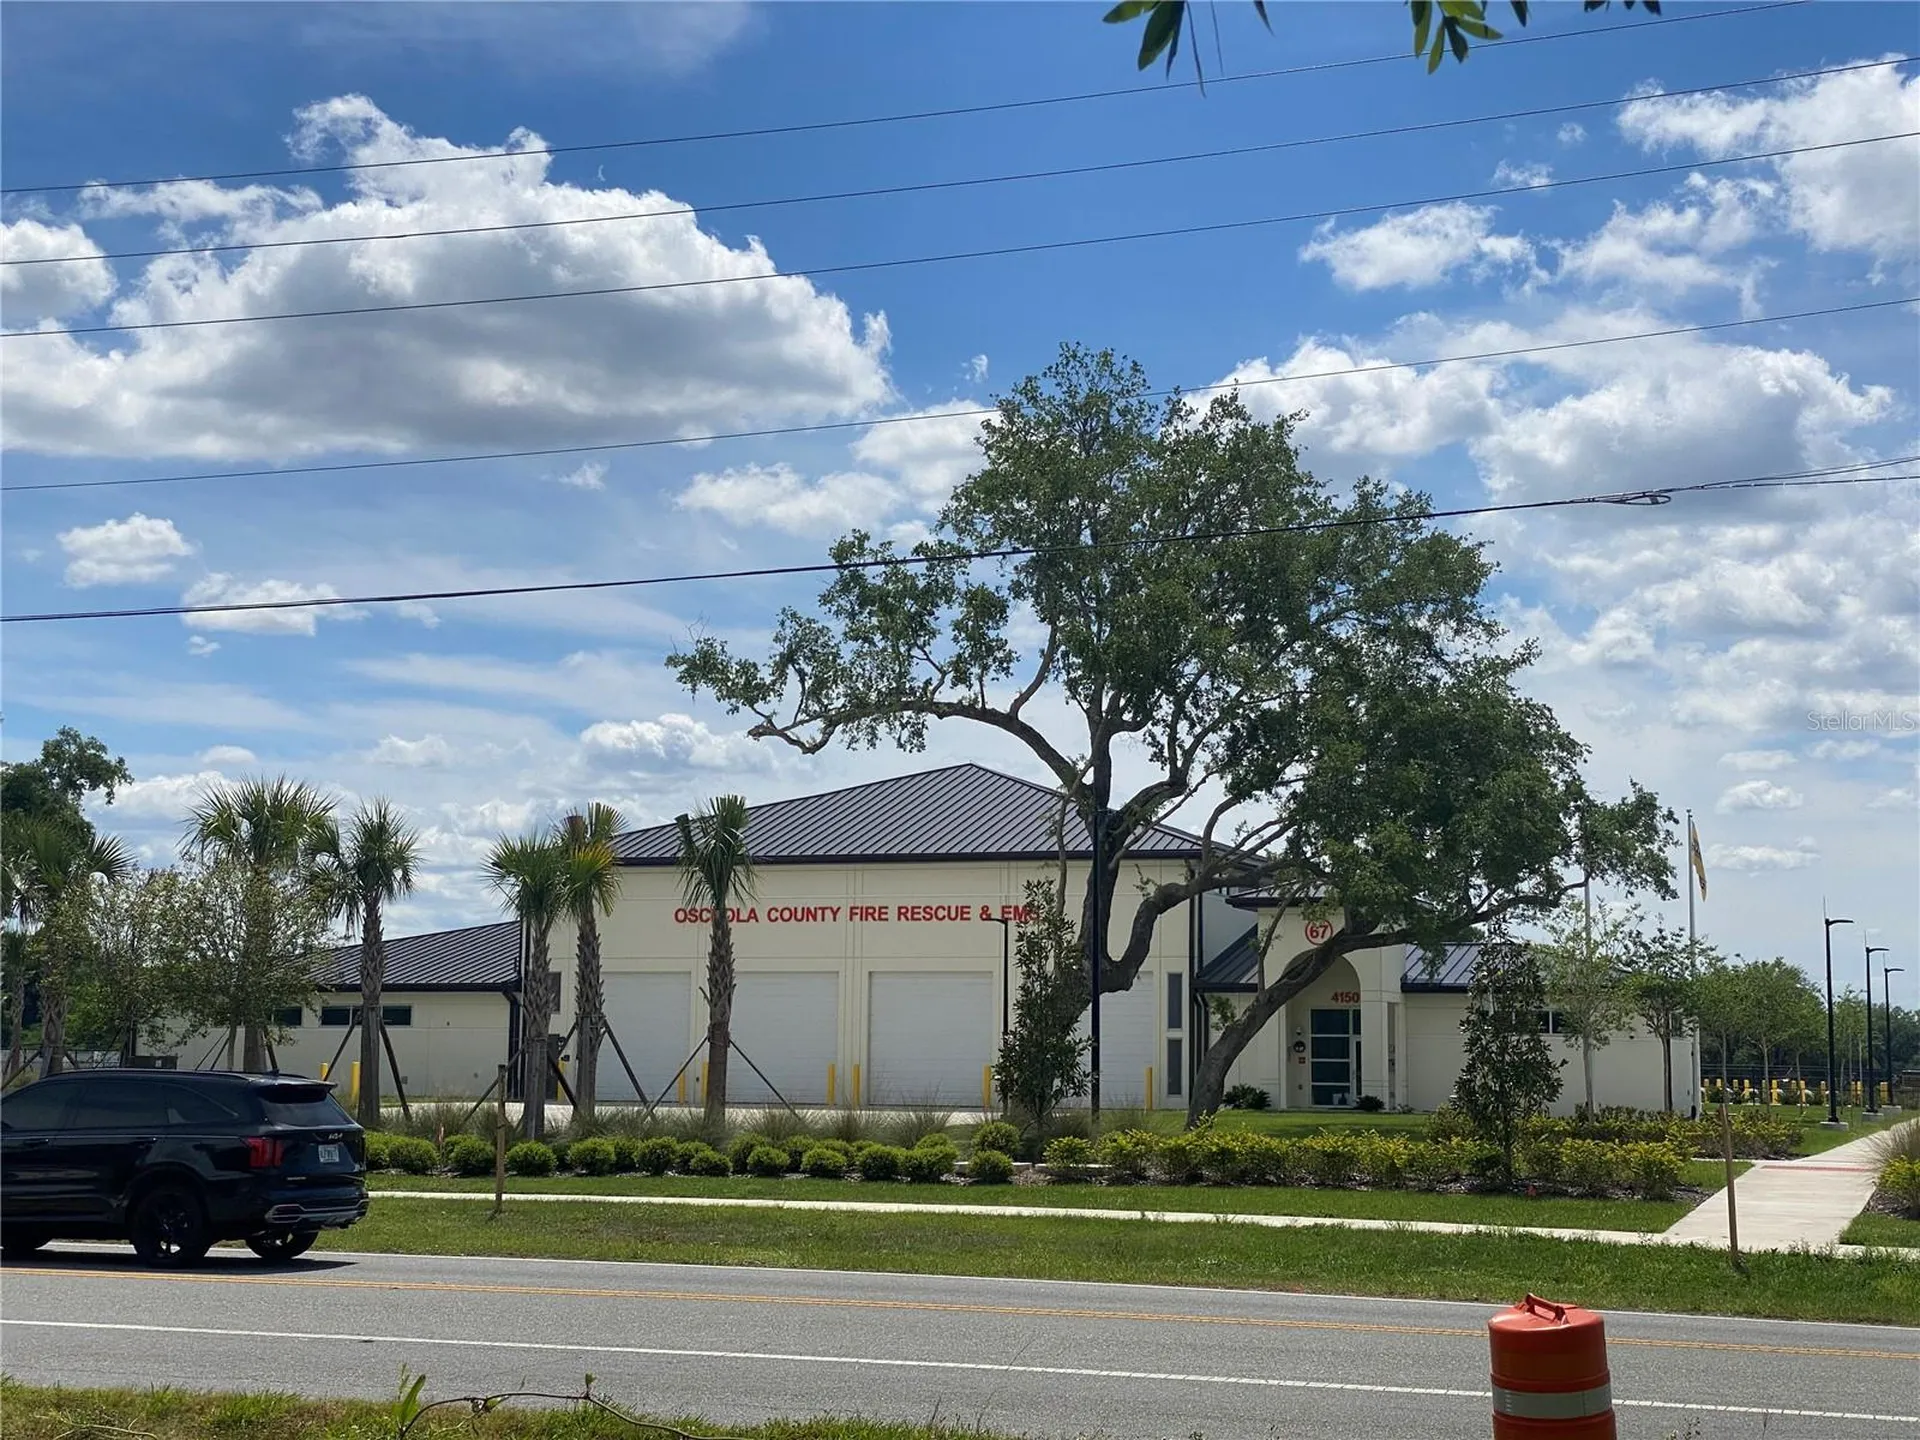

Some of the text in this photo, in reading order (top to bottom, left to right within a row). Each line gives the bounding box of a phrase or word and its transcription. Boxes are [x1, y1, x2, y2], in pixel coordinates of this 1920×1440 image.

[674, 907, 760, 923] OSCOLA
[767, 906, 841, 922] COUNTY
[848, 905, 889, 922] FIRE
[897, 905, 971, 921] RESCUE
[979, 904, 992, 921] &
[1309, 923, 1329, 939] 67
[1331, 991, 1360, 1003] 4150
